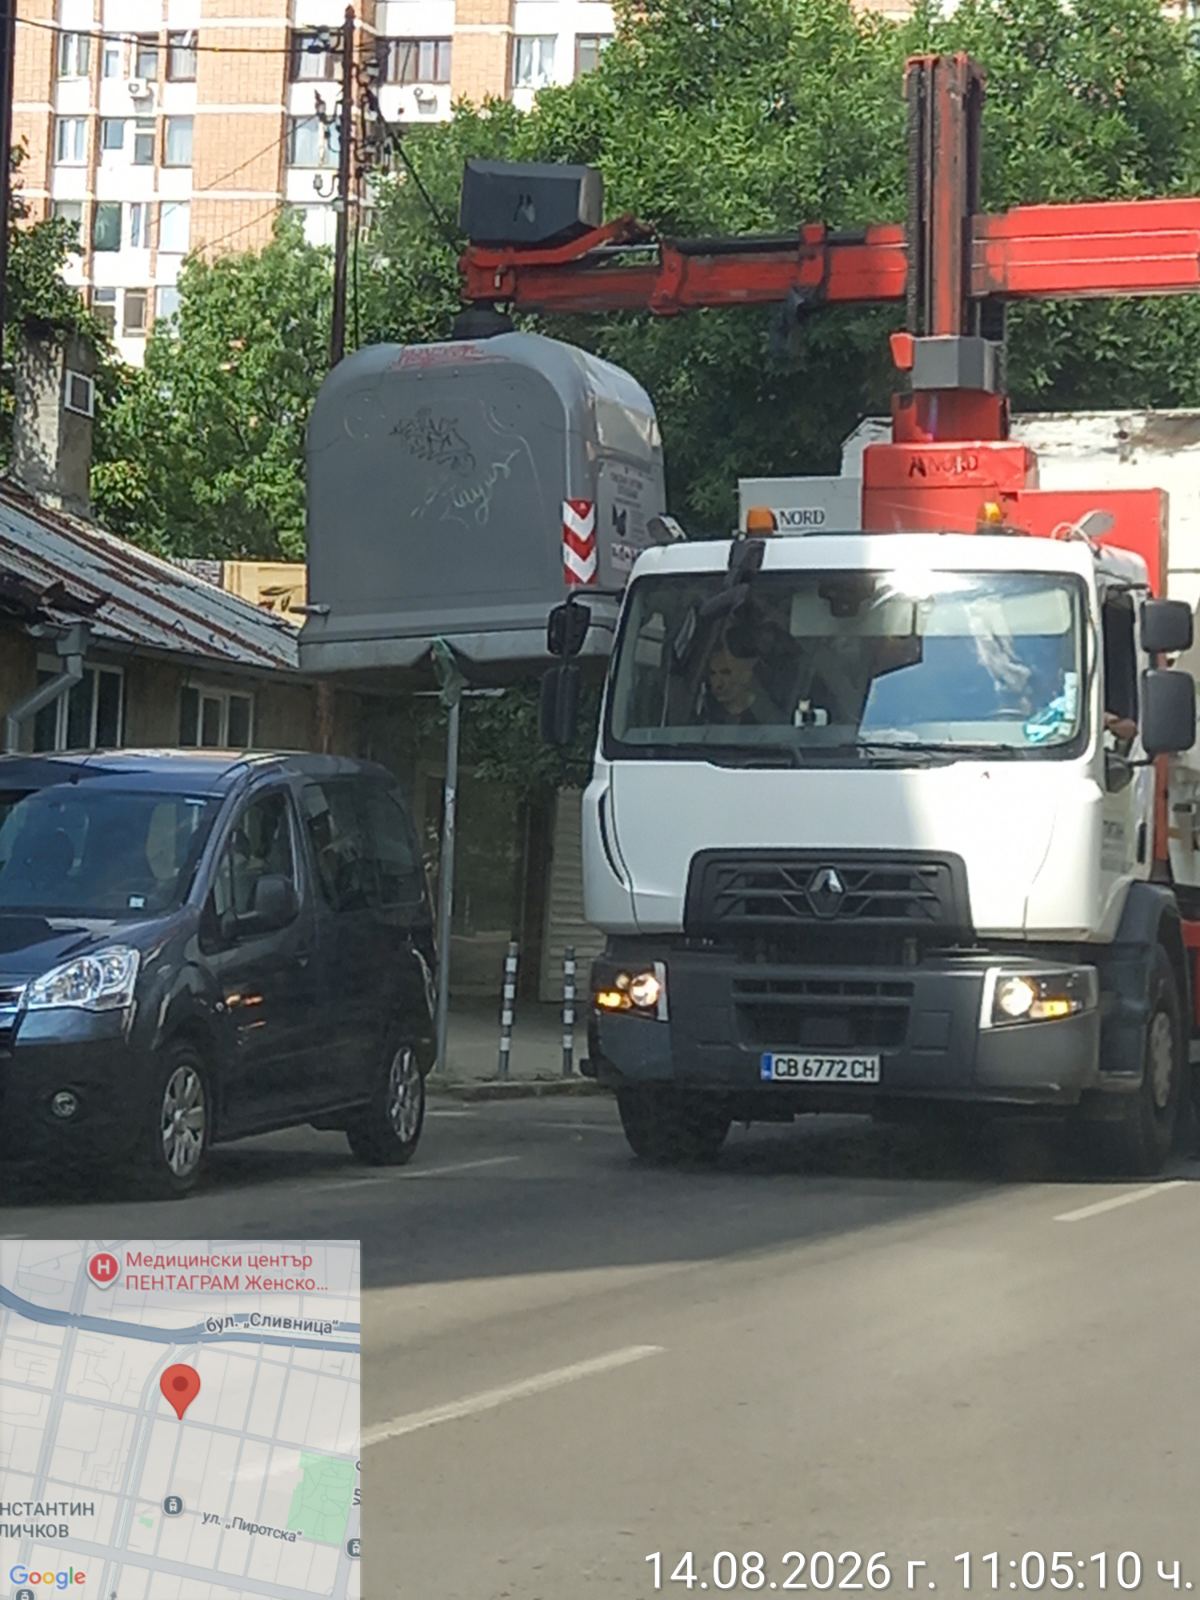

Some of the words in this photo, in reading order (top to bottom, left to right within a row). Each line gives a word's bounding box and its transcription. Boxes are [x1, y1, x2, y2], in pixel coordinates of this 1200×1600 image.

[780, 509, 825, 525] NORD
[775, 1058, 799, 1077] CB
[802, 1059, 848, 1078] 6772
[851, 1060, 875, 1078] CH
